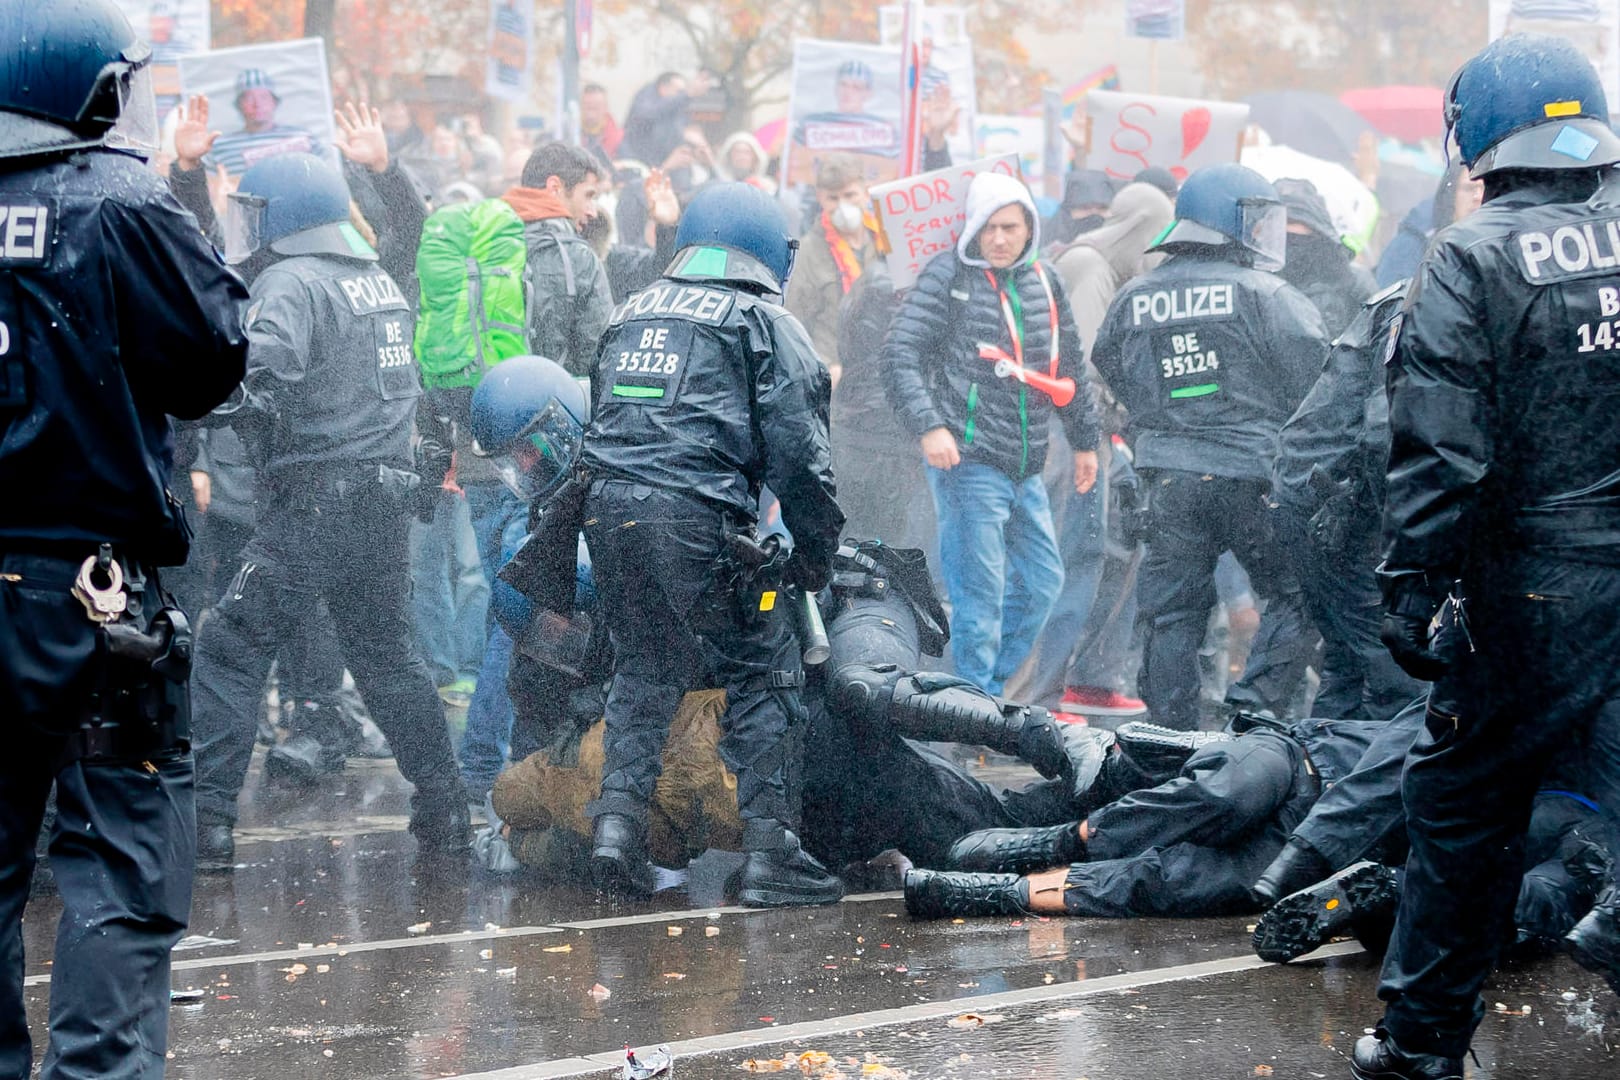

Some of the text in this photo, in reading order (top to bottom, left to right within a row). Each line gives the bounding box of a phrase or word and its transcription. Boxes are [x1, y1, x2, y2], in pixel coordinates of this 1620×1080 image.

[885, 166, 956, 216] DDR
[1519, 220, 1620, 278] POLI
[340, 274, 406, 310] POLIZ
[616, 286, 732, 321] POLIZEI
[1132, 284, 1234, 326] POLIZEI
[1598, 287, 1620, 317] B
[385, 321, 403, 343] BE
[640, 328, 669, 349] BE
[1171, 332, 1200, 355] BE
[616, 351, 679, 375] 35128
[1161, 350, 1219, 378] 35124
